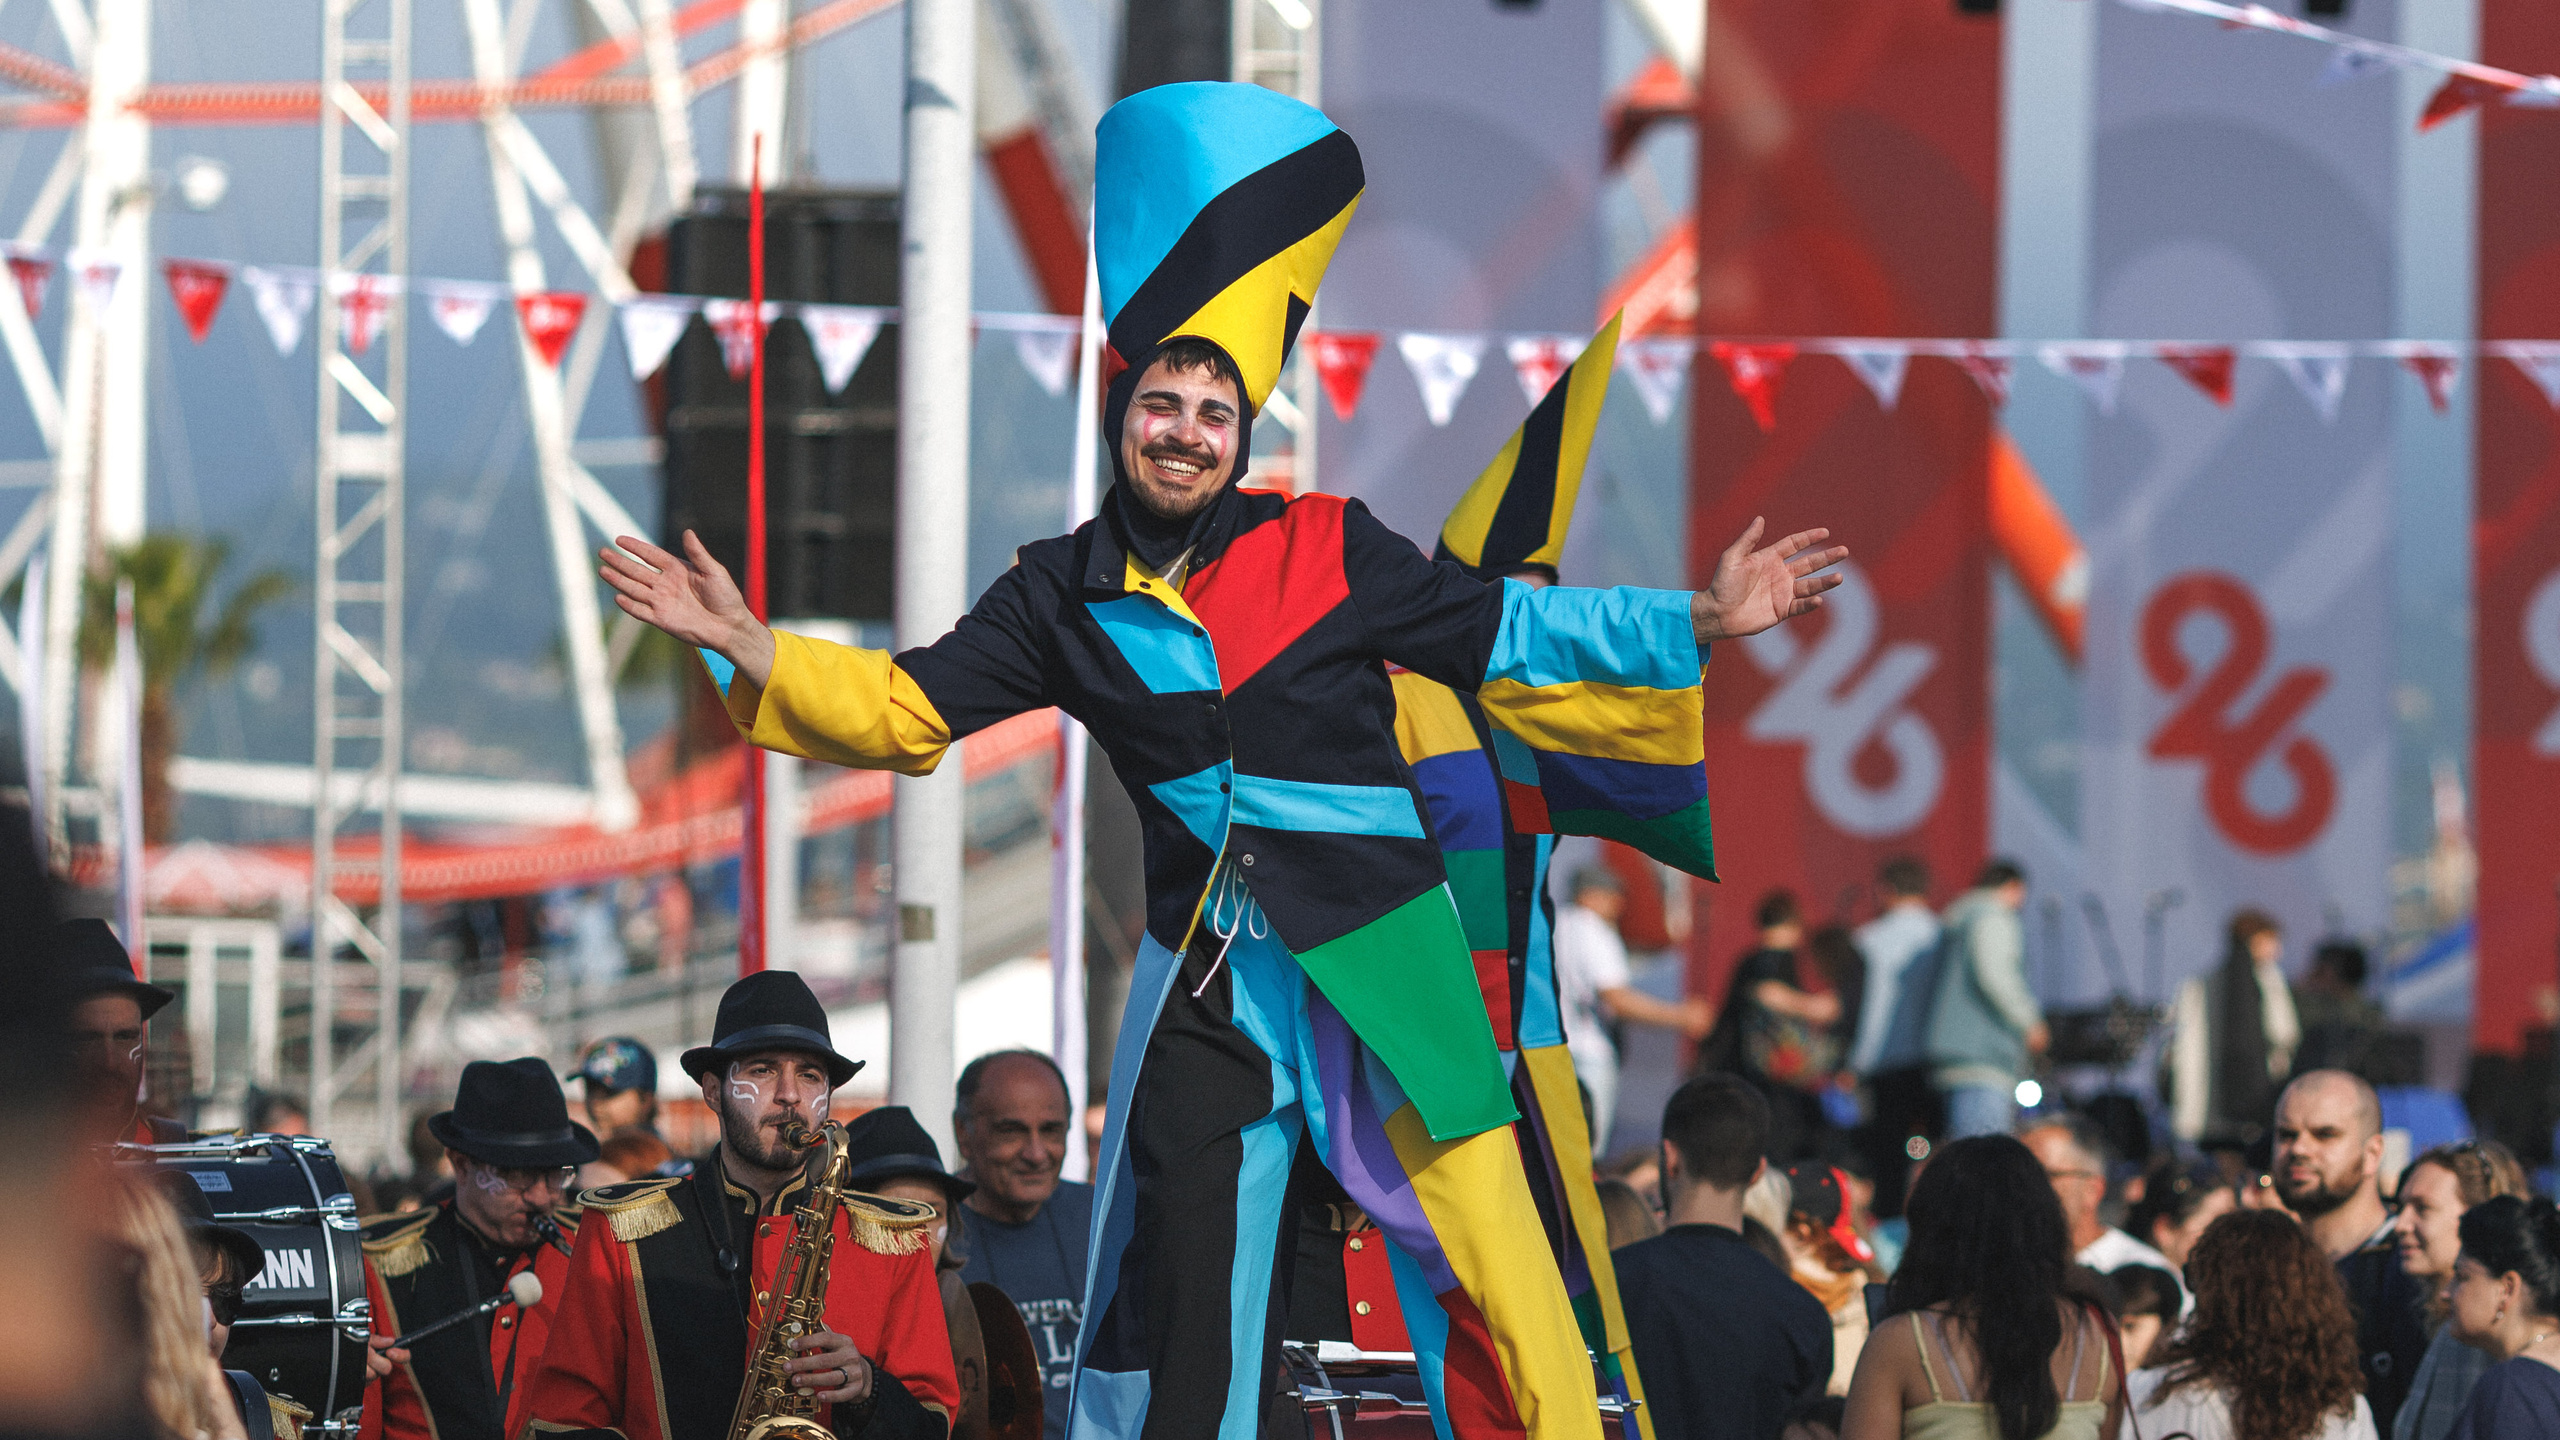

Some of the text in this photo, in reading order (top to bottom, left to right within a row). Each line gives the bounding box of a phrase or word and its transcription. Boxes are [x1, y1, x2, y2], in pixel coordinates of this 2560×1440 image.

[1738, 541, 1941, 834] 26
[2138, 569, 2337, 857] 26
[1015, 1298, 1084, 1325] VER
[1042, 1325, 1080, 1365] L
